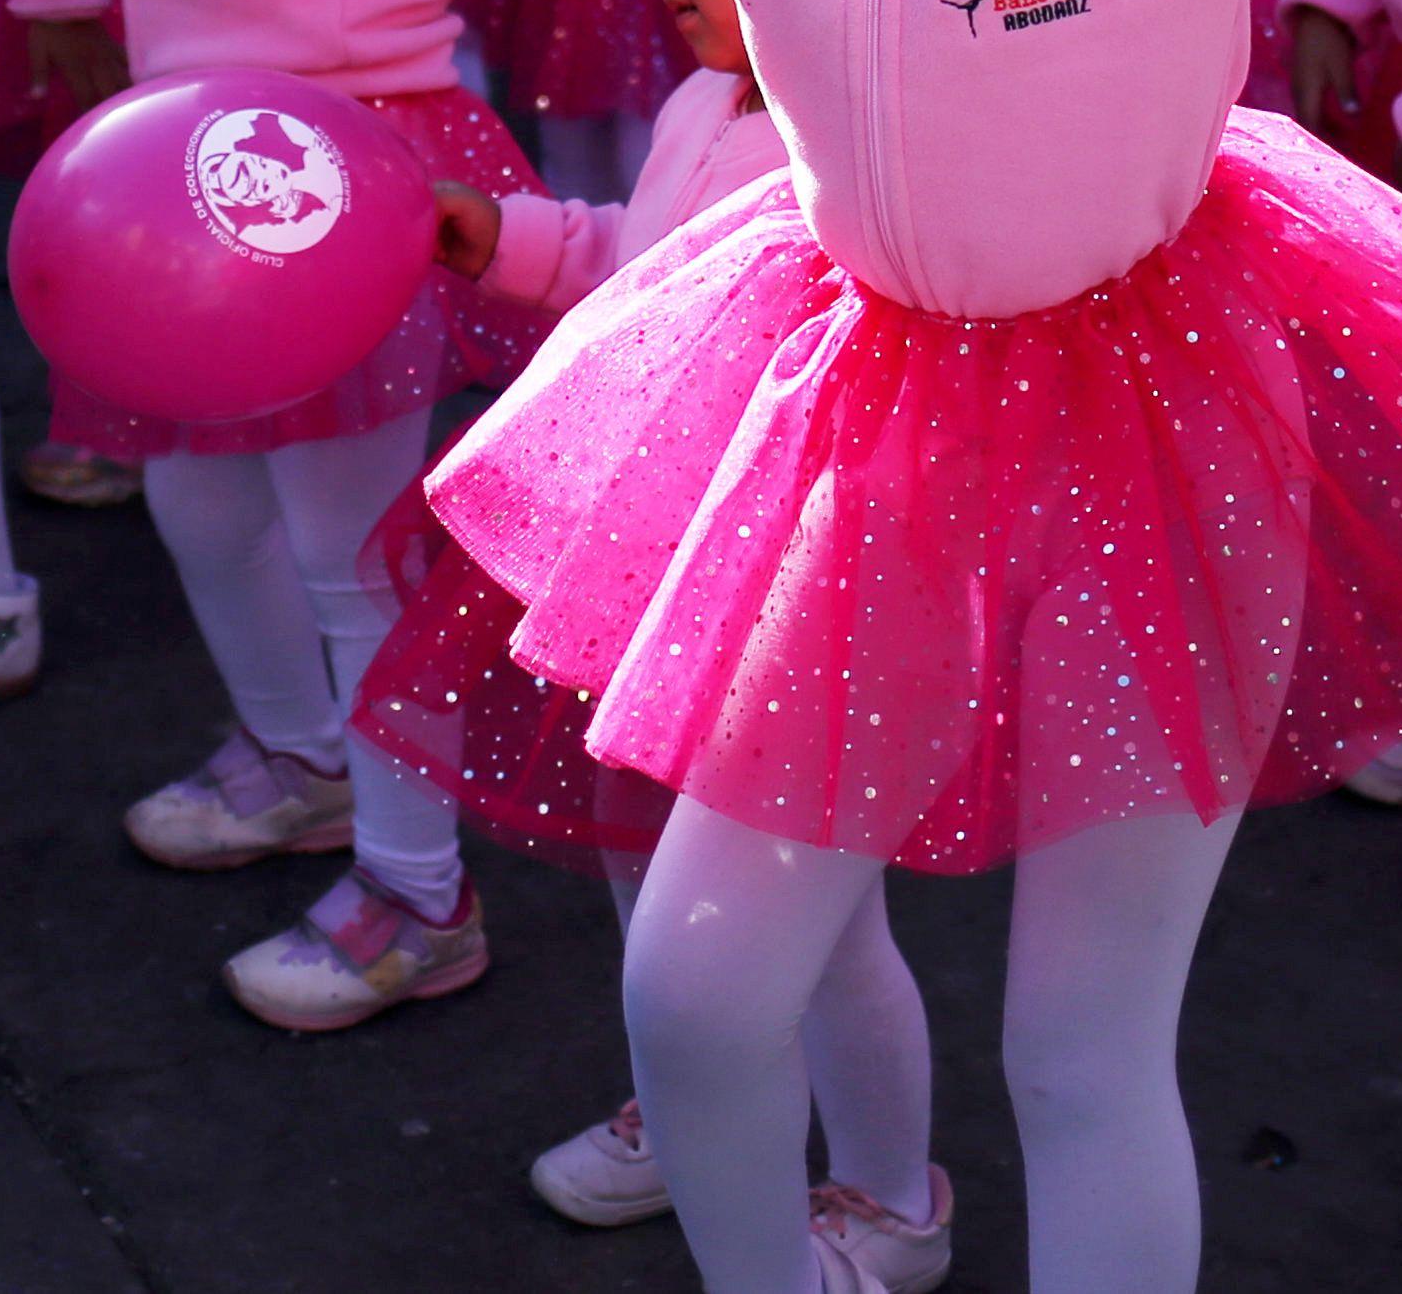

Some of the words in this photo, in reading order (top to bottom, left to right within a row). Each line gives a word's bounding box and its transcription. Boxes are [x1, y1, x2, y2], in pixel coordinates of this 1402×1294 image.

[184, 109, 224, 198] COLECCIONISTAS
[192, 200, 208, 220] DE
[206, 219, 250, 258] OFICIAL
[251, 251, 284, 268] CLUB
